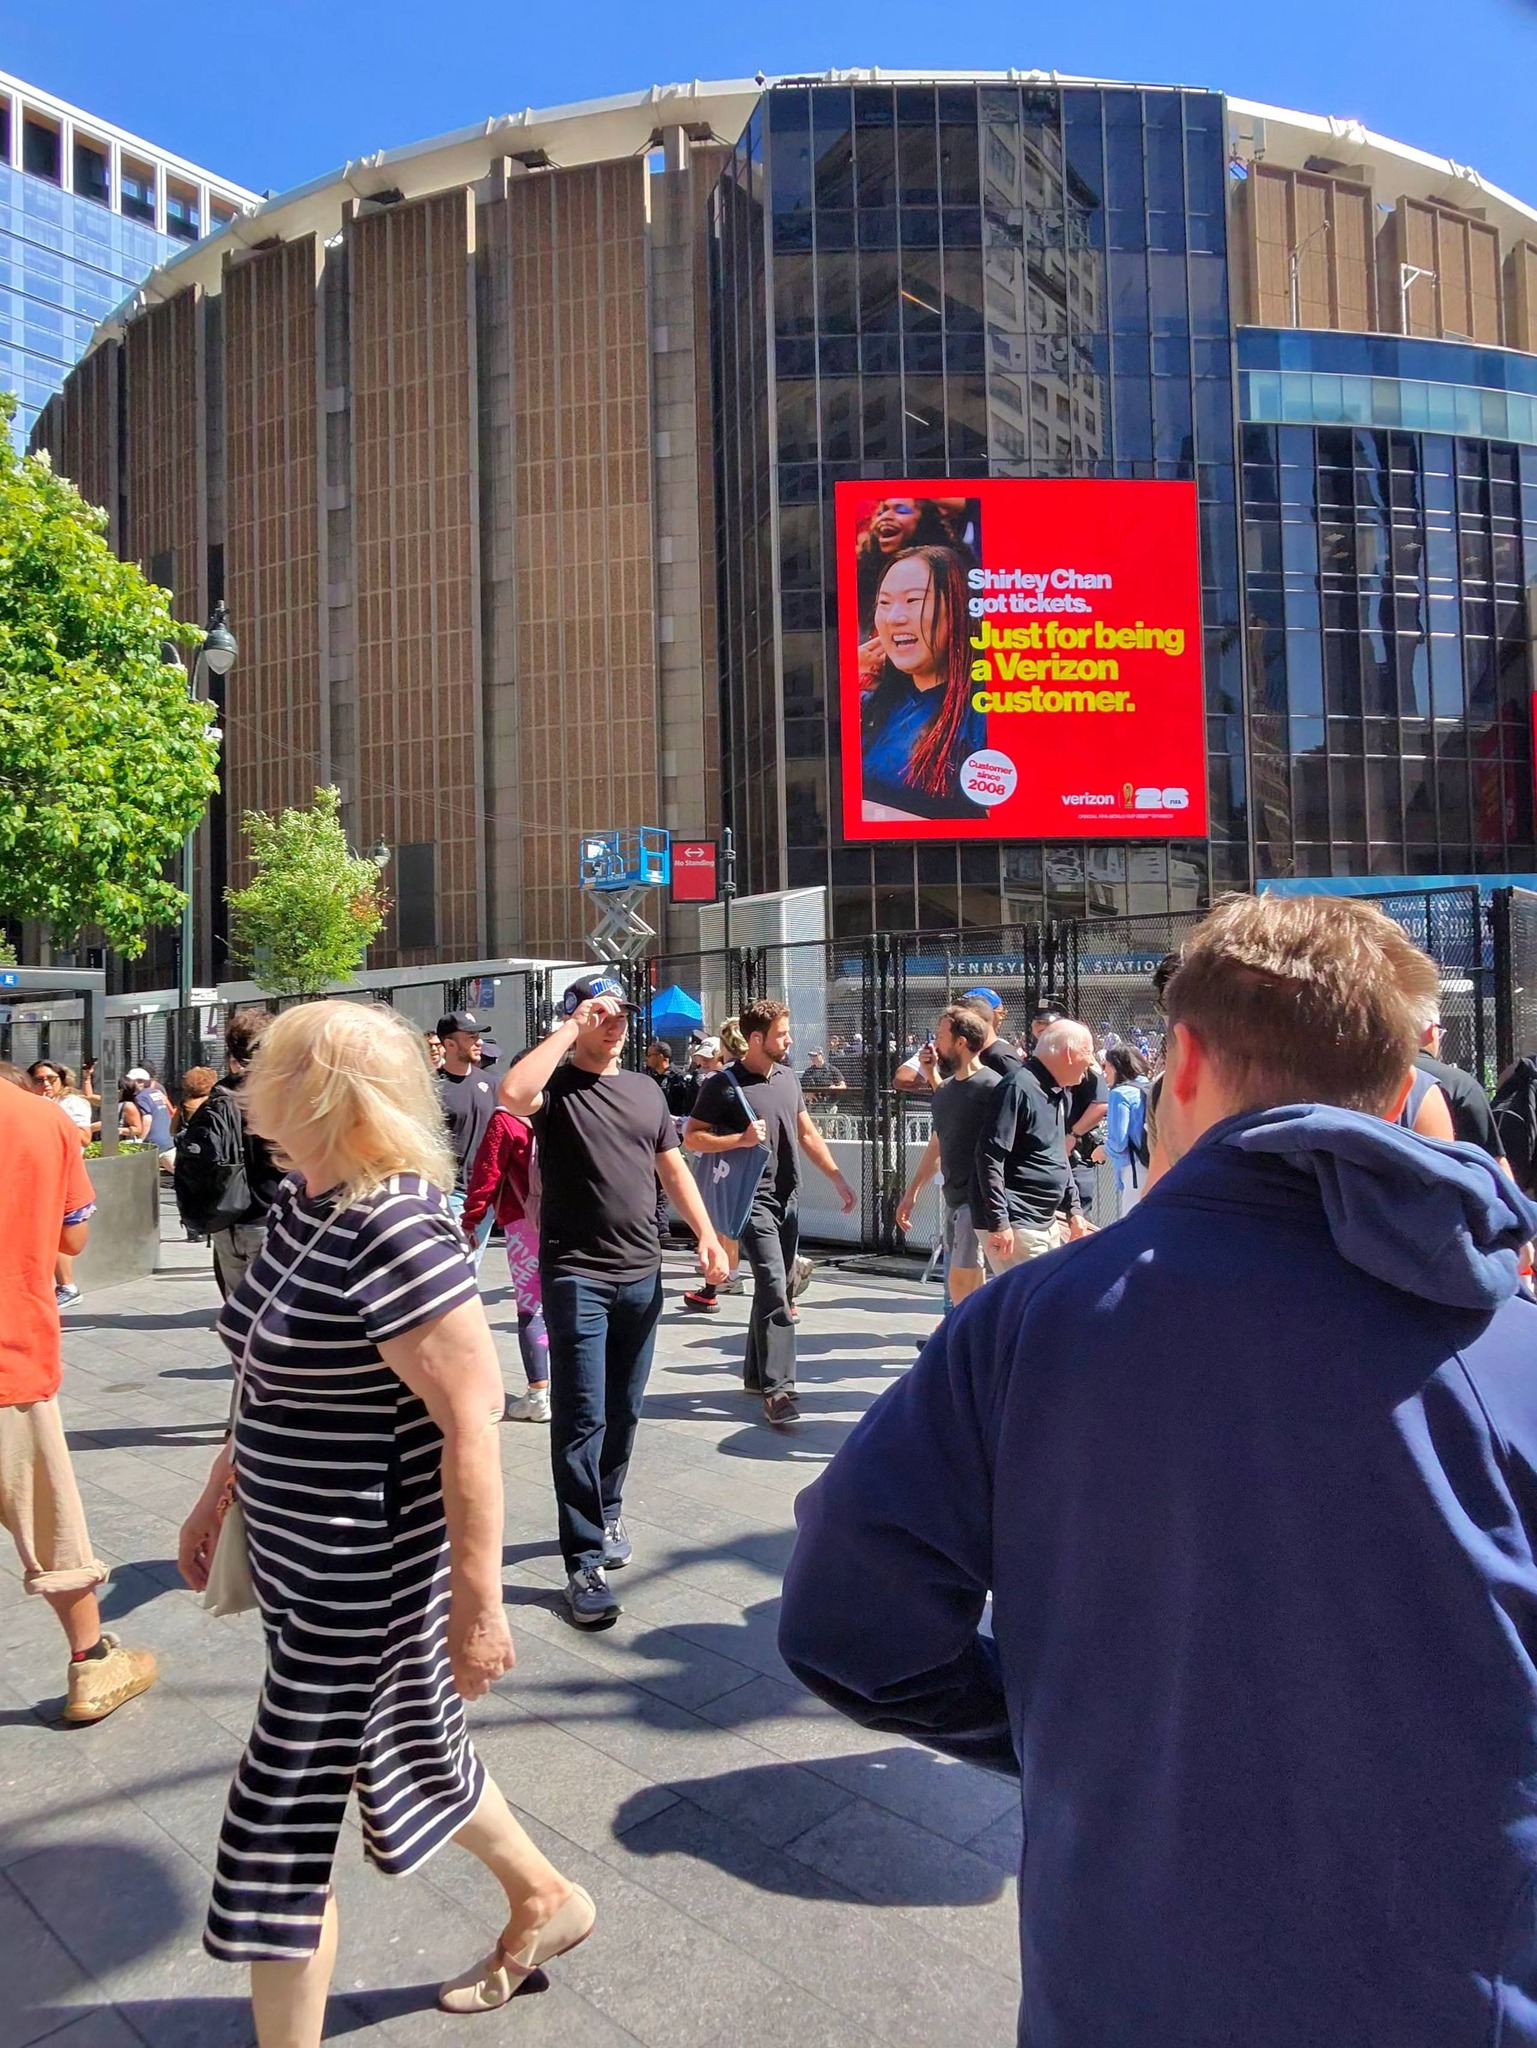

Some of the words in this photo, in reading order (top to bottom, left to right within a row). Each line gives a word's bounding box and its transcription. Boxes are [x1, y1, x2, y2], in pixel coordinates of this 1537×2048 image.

[968, 568, 1049, 593] Shirley
[1050, 568, 1112, 589] Chan
[968, 594, 1008, 617] got
[1010, 593, 1092, 613] tickets.
[970, 621, 1042, 649] Just
[1046, 621, 1093, 649] for
[1095, 621, 1185, 656] being
[971, 660, 992, 681] a
[993, 652, 1118, 681] Verizon
[971, 685, 1135, 712] customer.
[968, 760, 1013, 775] Customer
[977, 771, 1001, 781] since
[967, 779, 1006, 795] 2008
[1061, 792, 1115, 806] verizon
[1135, 787, 1190, 809] 26
[685, 859, 715, 867] Standing
